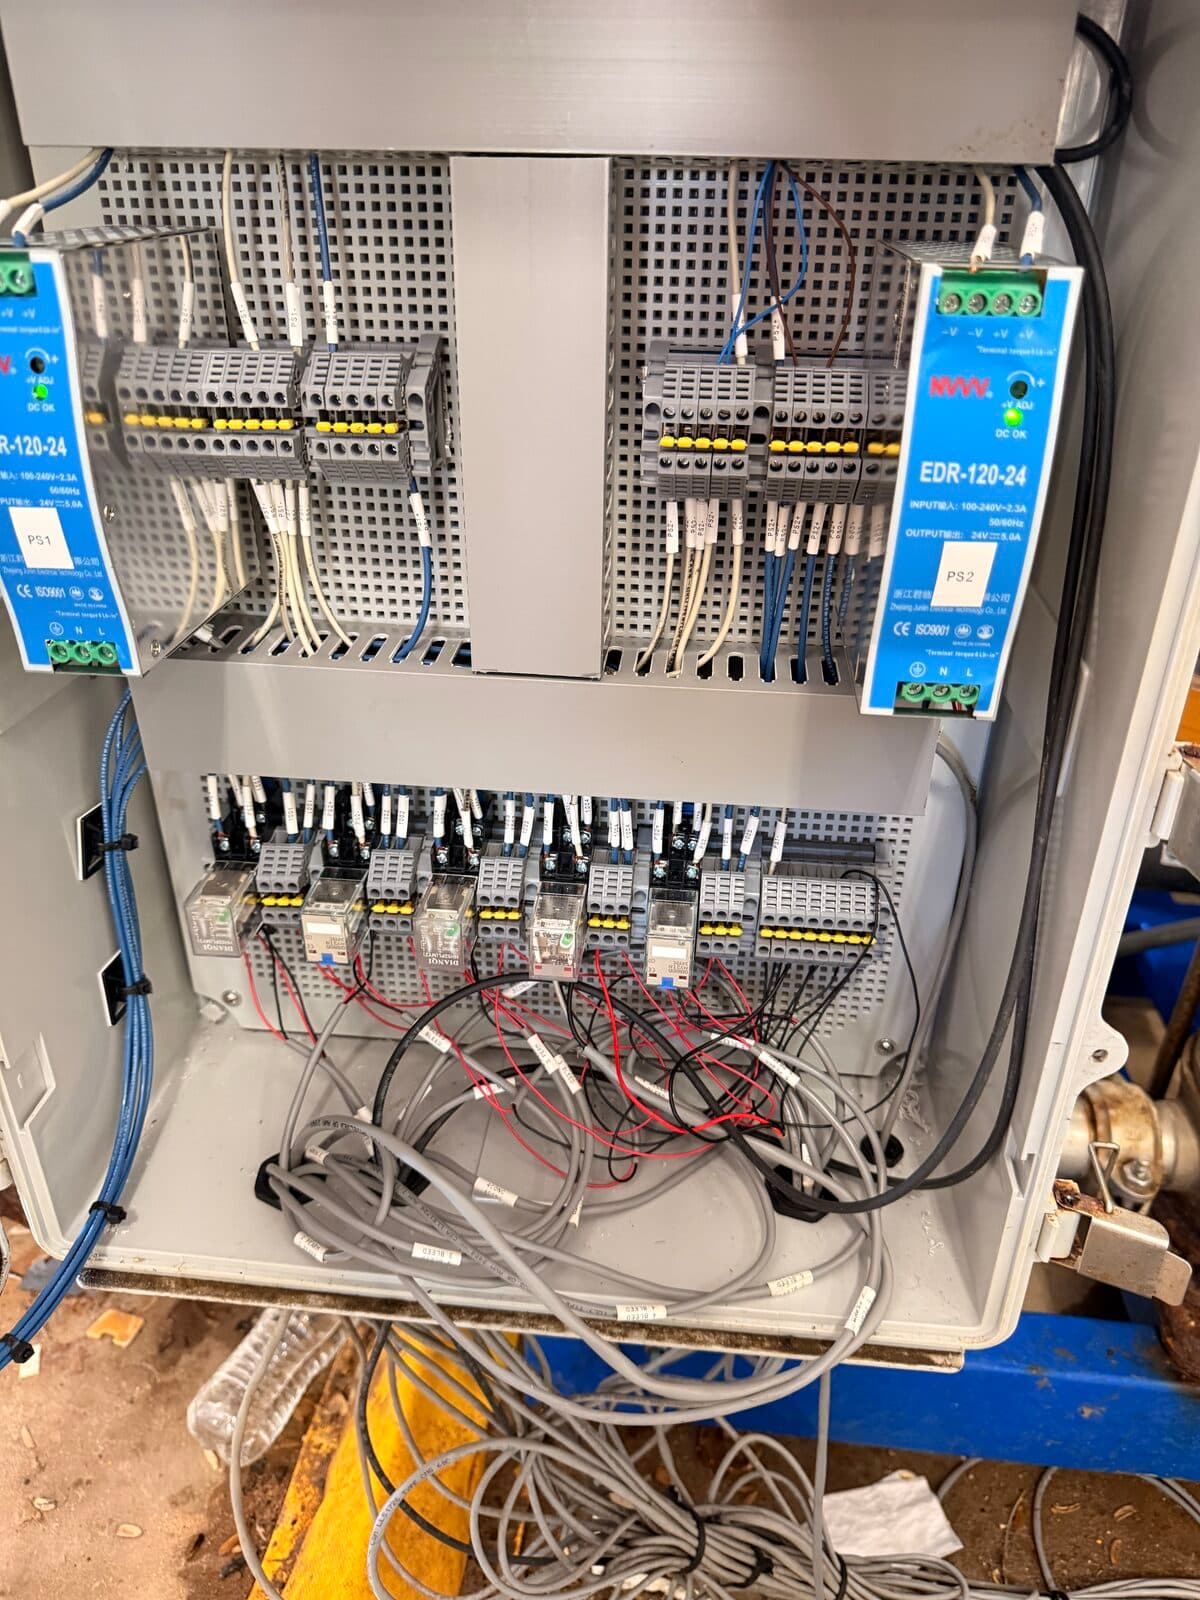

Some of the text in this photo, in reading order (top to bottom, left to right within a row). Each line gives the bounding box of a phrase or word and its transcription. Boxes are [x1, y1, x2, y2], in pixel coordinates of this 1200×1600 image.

[28, 402, 56, 413] DC OK
[1015, 401, 1033, 410] ADJ
[995, 429, 1027, 439] DC OK
[920, 460, 1028, 486] EDR-120-24
[27, 534, 52, 546] PS1
[946, 571, 975, 583] PS2
[75, 626, 84, 636] N
[98, 626, 106, 636] L
[893, 622, 911, 636] CE
[915, 623, 950, 637] ISO9001
[939, 666, 948, 677] N
[966, 667, 974, 677] L
[202, 943, 234, 952] DIANQI
[428, 957, 460, 967] DIANQI
